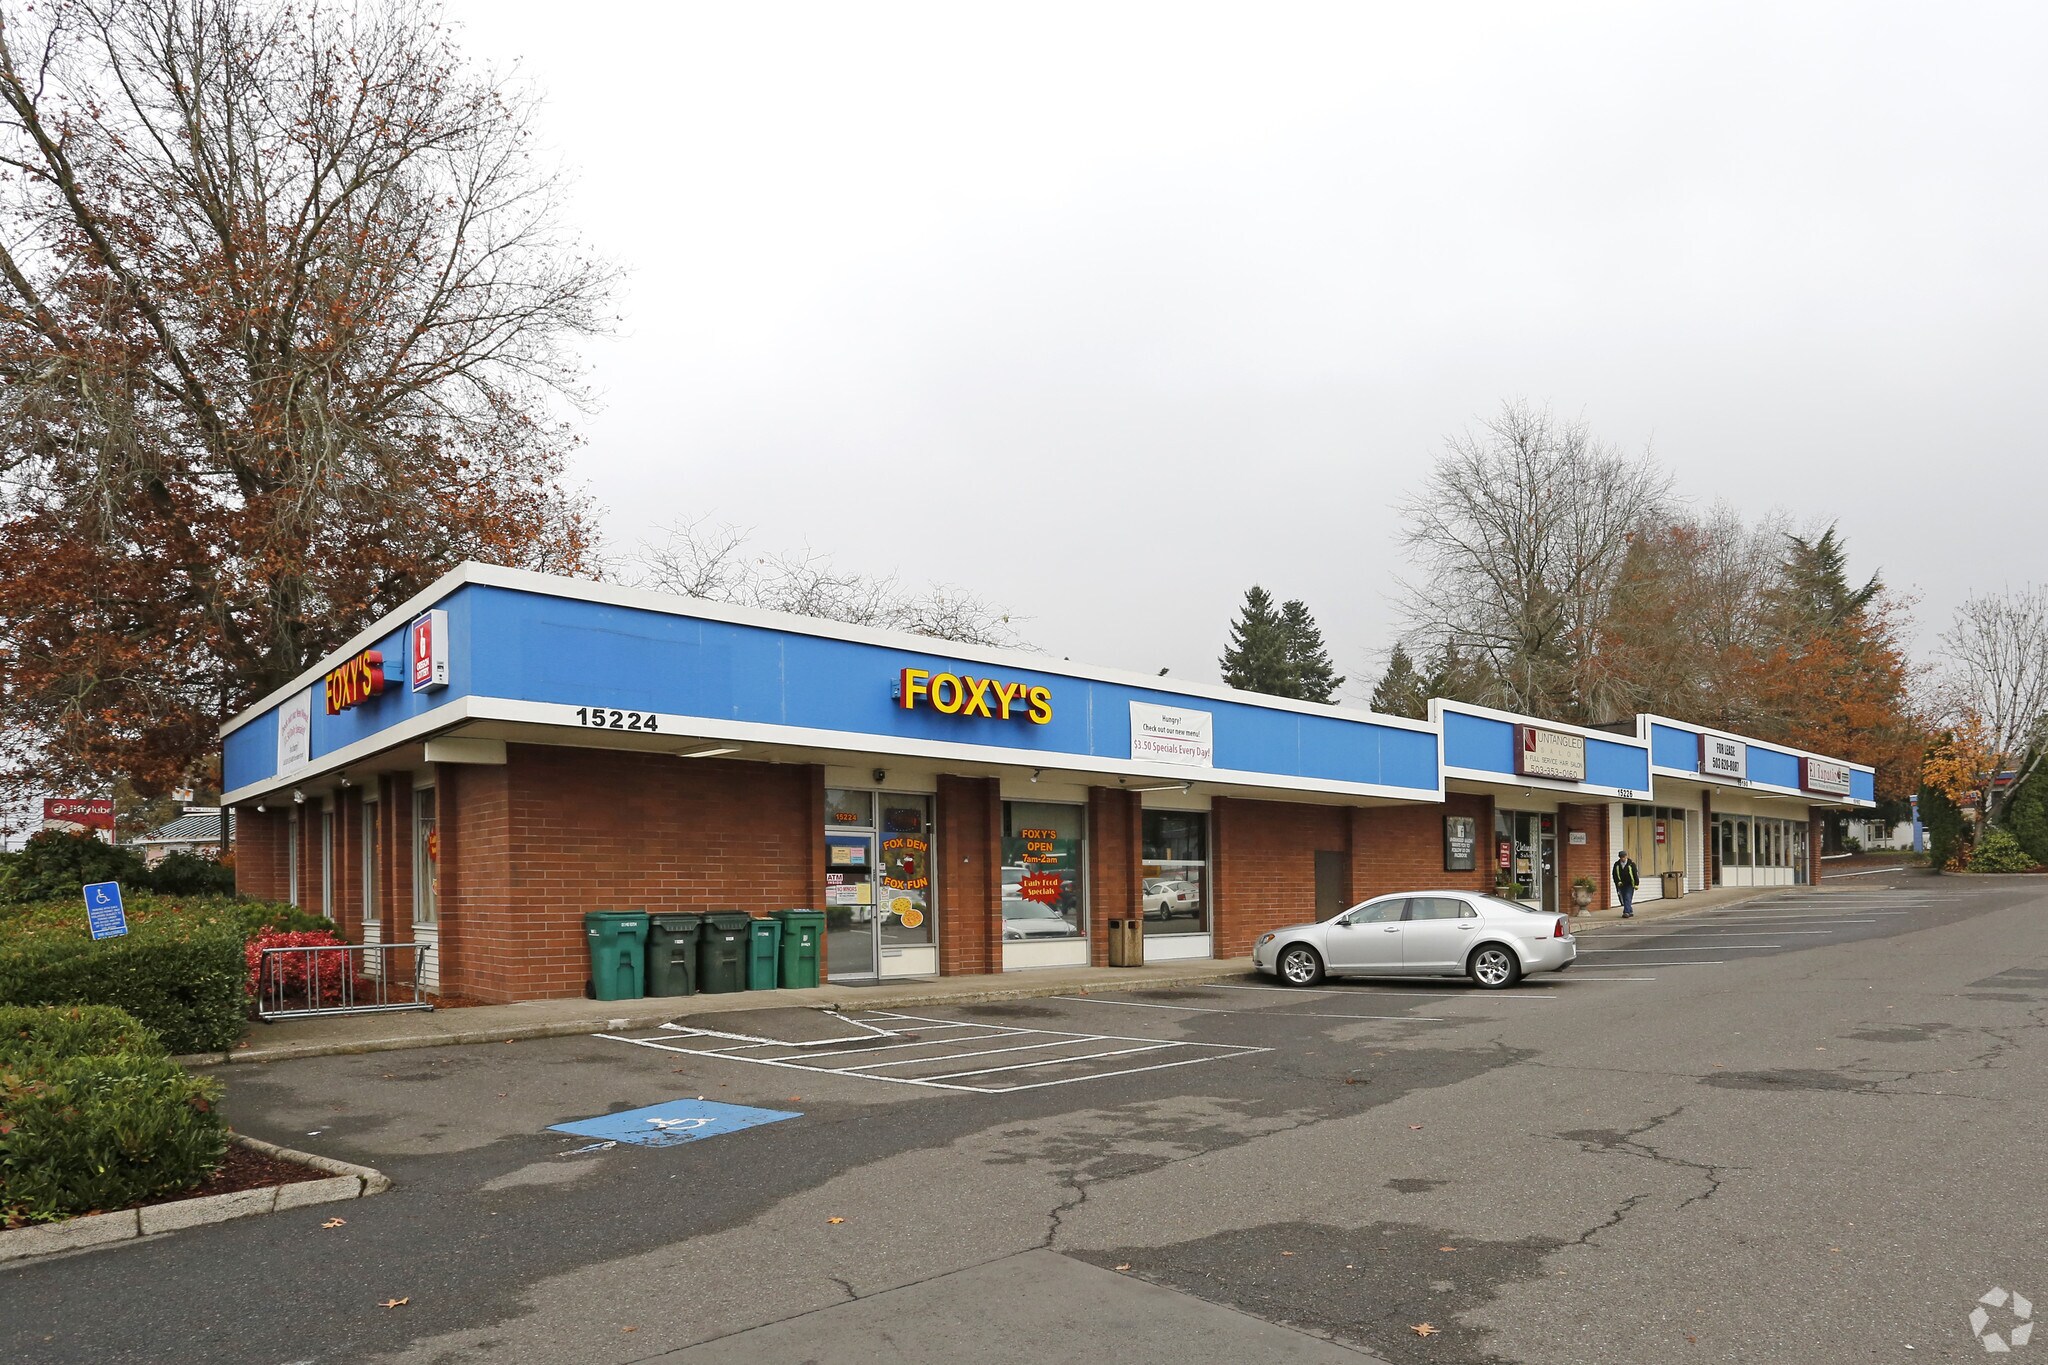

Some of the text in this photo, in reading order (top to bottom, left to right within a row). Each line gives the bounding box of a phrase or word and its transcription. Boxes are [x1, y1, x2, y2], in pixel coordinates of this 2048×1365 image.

[326, 650, 373, 715] FOXY'S
[902, 668, 1053, 725] FOXY'S
[576, 707, 658, 731] 15224
[1162, 714, 1182, 725] Hungry?
[1143, 723, 1157, 732] Check
[1537, 732, 1583, 749] UNTANGLED
[1134, 739, 1211, 759] $3.50 Specials Every Day!
[1716, 743, 1735, 756] FOR LEASE
[1530, 754, 1540, 763] FULL
[1541, 756, 1558, 765] SERVICE
[1712, 757, 1720, 768] 503
[1530, 764, 1578, 779] 503-353-0160
[1809, 762, 1816, 777] El
[1617, 788, 1633, 797] 15226
[69, 804, 91, 815] jiffy
[835, 813, 857, 821] 15224
[1022, 829, 1057, 839] FOXY'S
[883, 839, 928, 851] FOX DEN
[1027, 842, 1053, 852] OPEN
[1022, 853, 1058, 864] 7am-2am
[827, 874, 843, 882] ATM
[884, 877, 928, 889] FOX FUN
[1023, 879, 1041, 887] Daily
[1028, 888, 1055, 896] Specials
